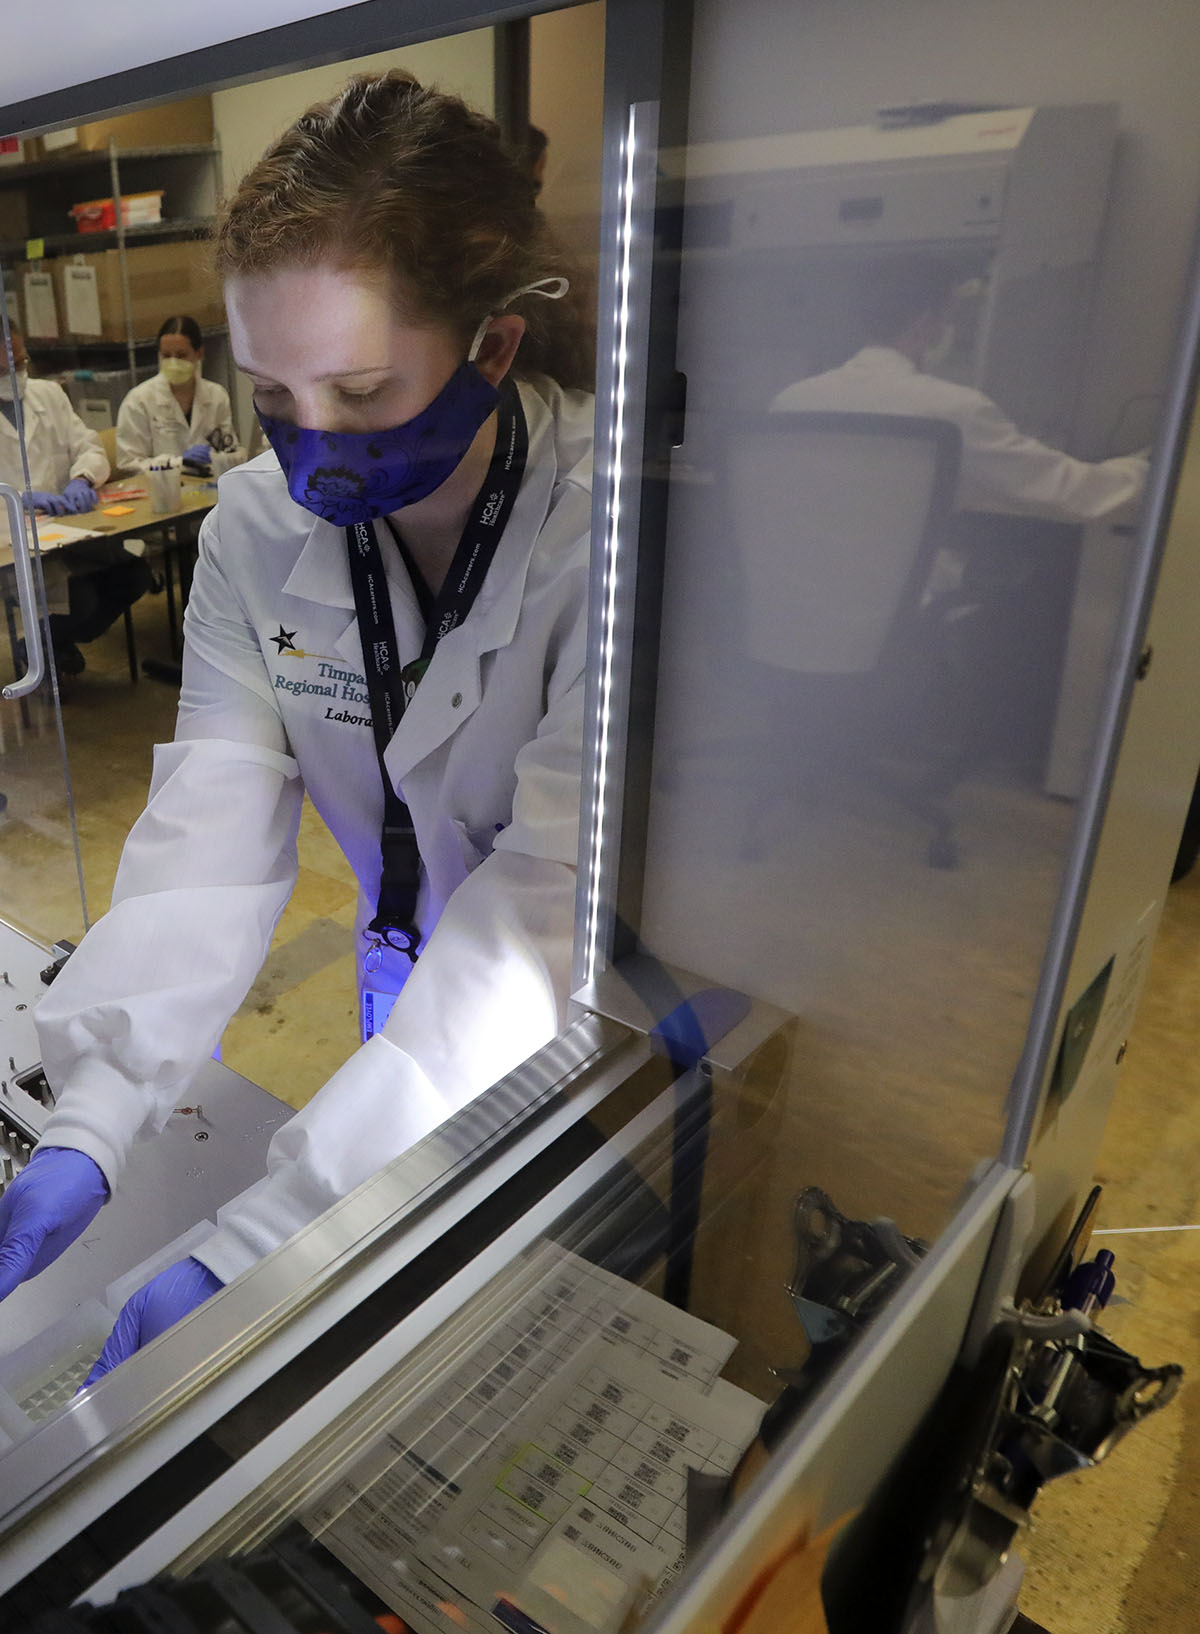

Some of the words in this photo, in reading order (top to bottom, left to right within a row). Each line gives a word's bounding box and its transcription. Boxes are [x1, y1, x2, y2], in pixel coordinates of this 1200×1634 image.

[480, 501, 497, 525] HCA
[357, 522, 369, 546] HCA
[458, 543, 481, 594] HCAcareers.com
[367, 574, 379, 625] HCAcareers.com
[379, 641, 390, 664] HCA
[274, 675, 337, 698] Regional
[318, 663, 368, 687] Timpa
[324, 708, 374, 728] Labora
